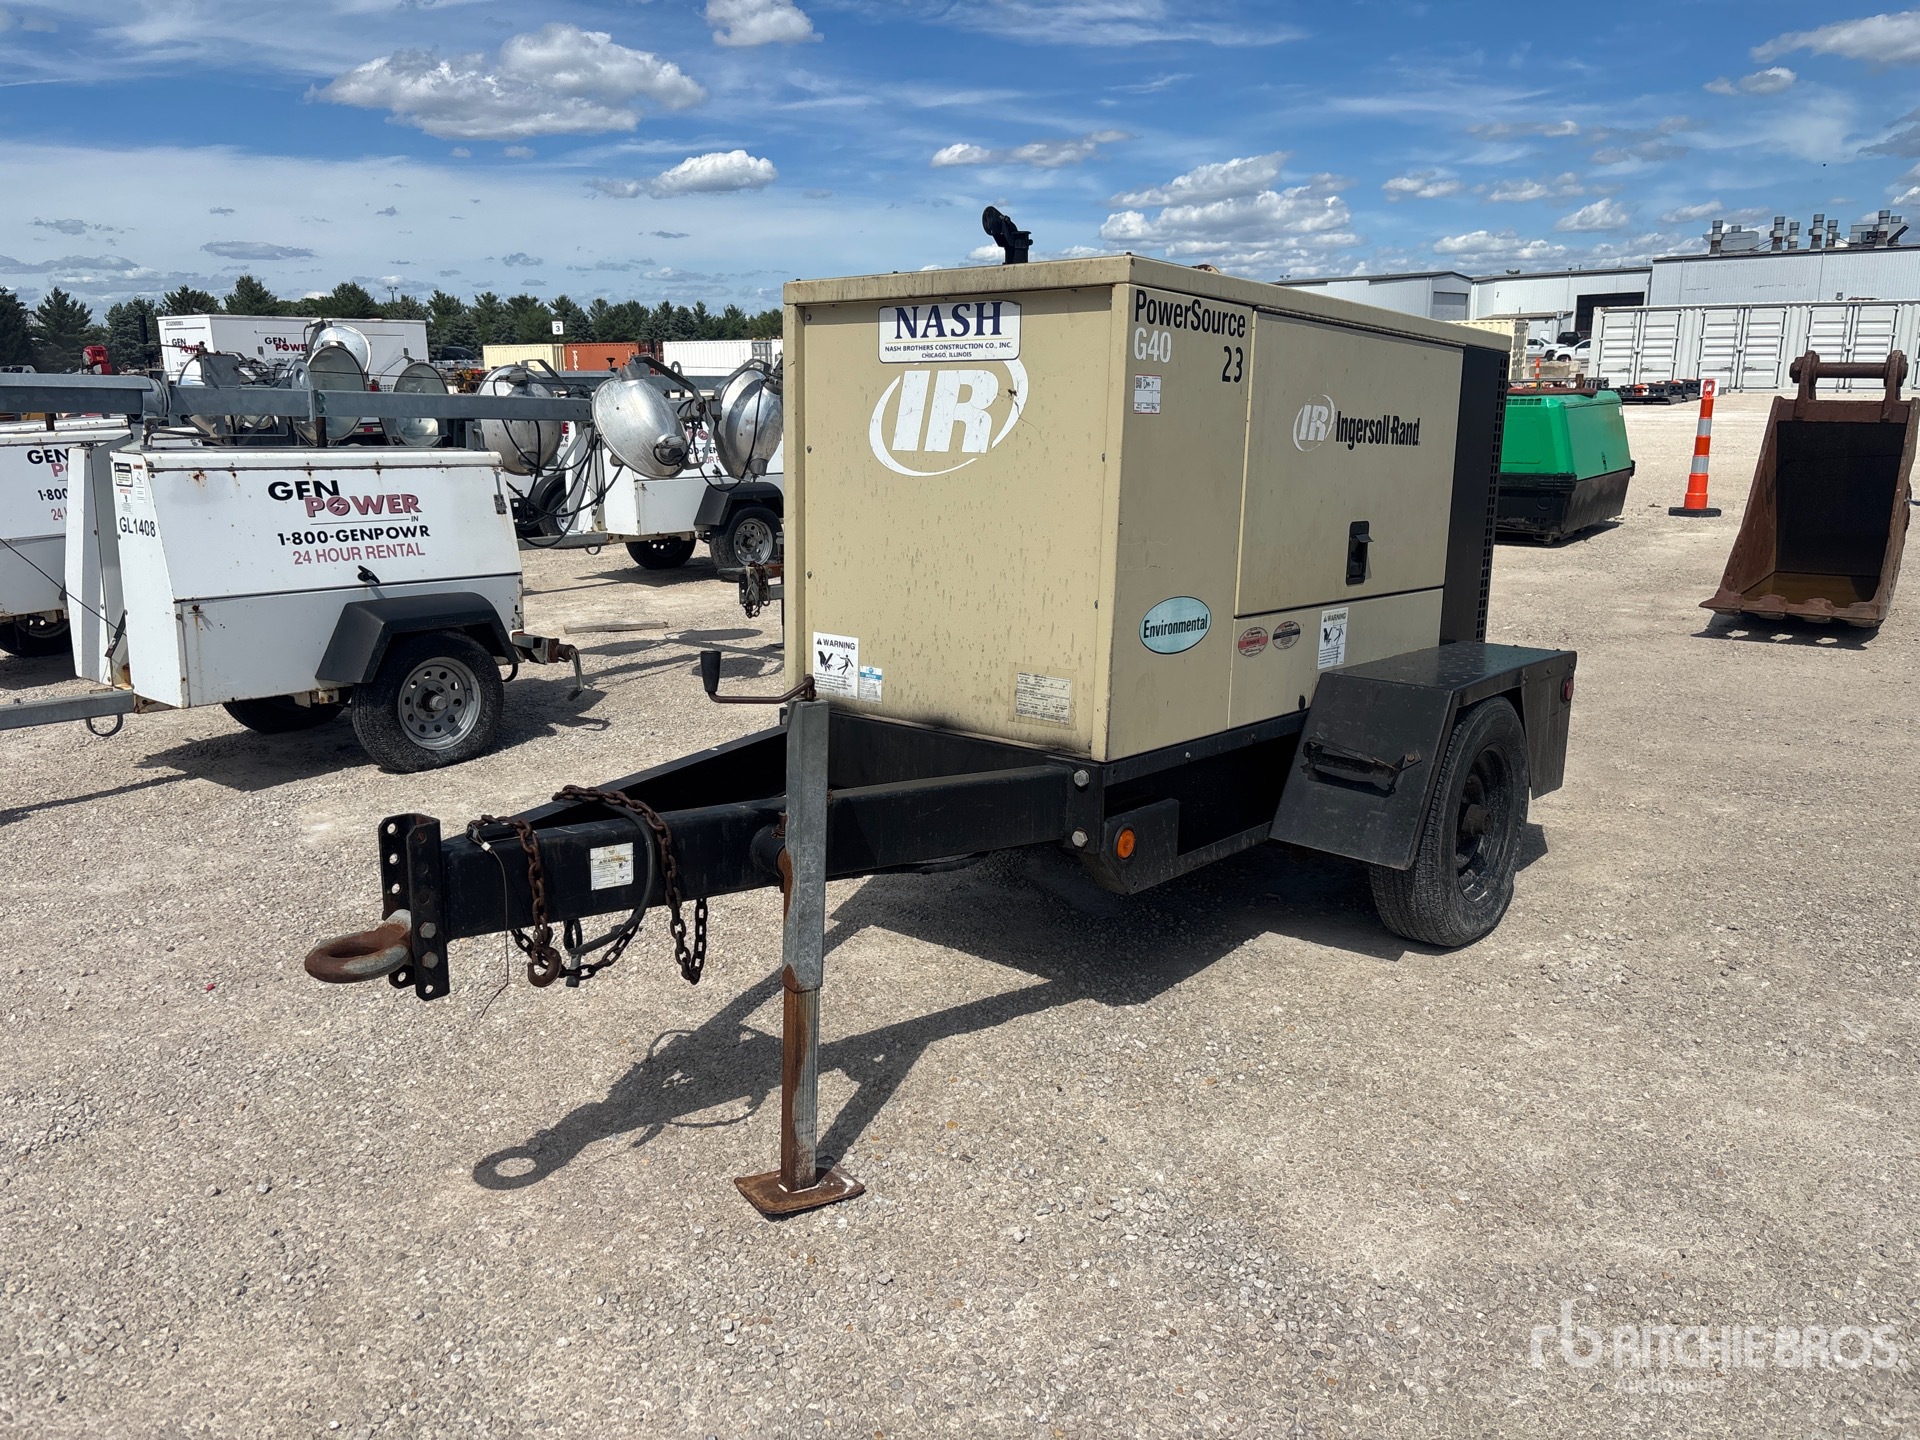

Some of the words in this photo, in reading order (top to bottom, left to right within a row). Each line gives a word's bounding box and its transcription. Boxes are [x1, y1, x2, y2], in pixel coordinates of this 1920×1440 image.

[894, 301, 1003, 340] NASH
[1134, 289, 1246, 339] PowerSource
[264, 336, 287, 345] GEN
[934, 342, 984, 351] CONSTRUCTION
[998, 341, 1013, 349] INC.
[1133, 327, 1172, 363] G40
[921, 351, 948, 359] CHICAGO,
[1221, 345, 1244, 383] 23
[892, 370, 998, 453] IR
[1298, 404, 1329, 442] IR
[267, 479, 340, 501] GEN
[51, 508, 64, 521] 24
[304, 493, 423, 518] POWER
[119, 516, 156, 538] GL1408
[277, 524, 431, 546] 1-800-GENPOWR
[292, 550, 313, 565] 24
[315, 546, 363, 564] HOUR
[364, 542, 426, 561] RENTAL
[1143, 613, 1208, 639] Environmental
[1327, 612, 1347, 622] WARNING
[823, 638, 856, 650] WARNING
